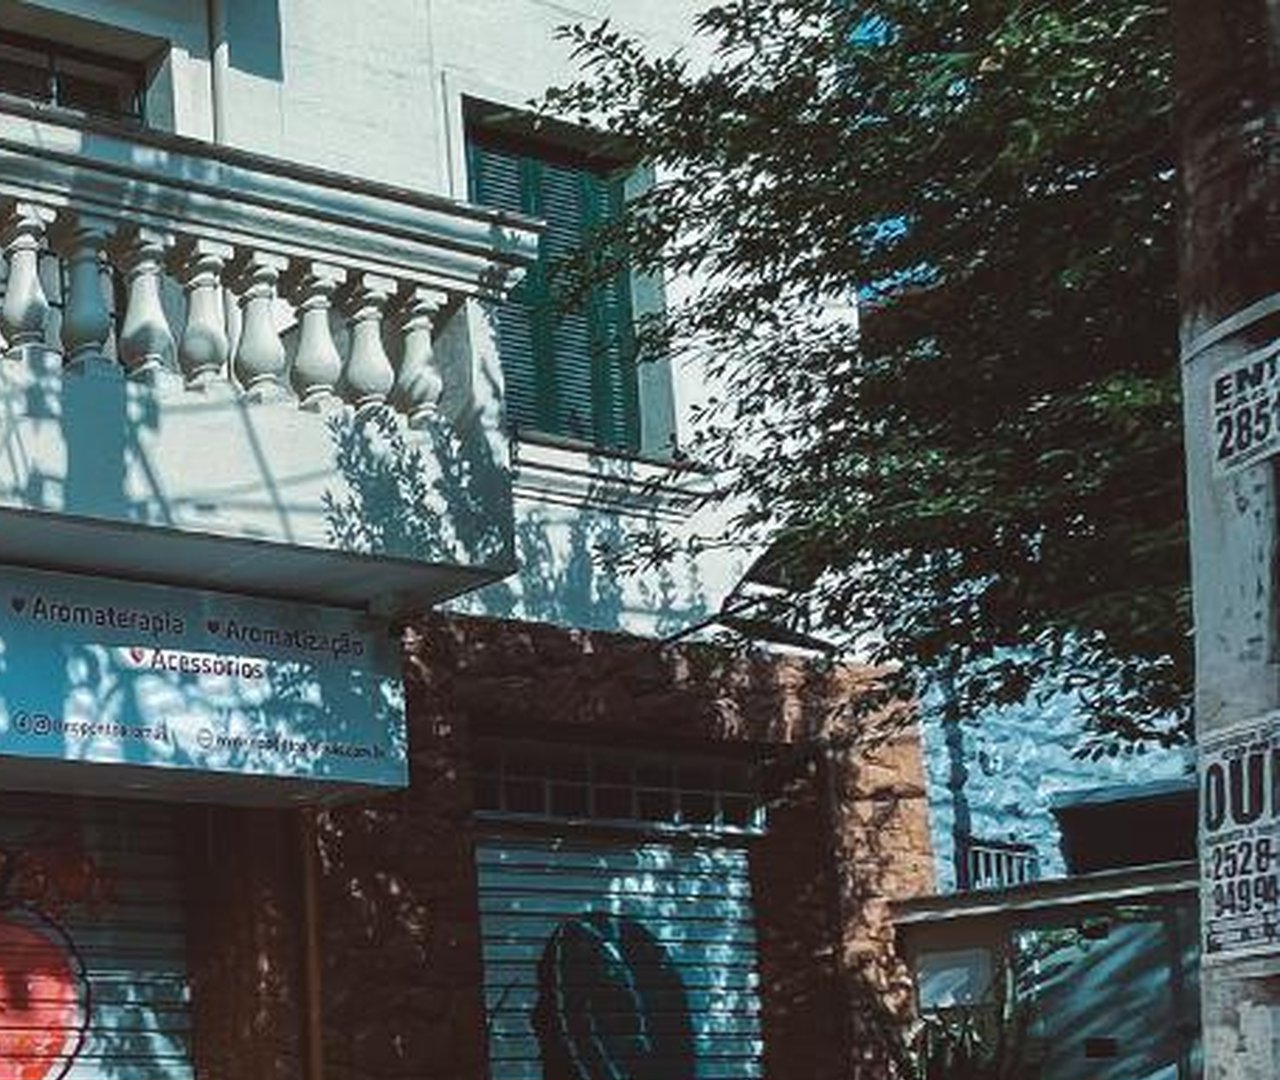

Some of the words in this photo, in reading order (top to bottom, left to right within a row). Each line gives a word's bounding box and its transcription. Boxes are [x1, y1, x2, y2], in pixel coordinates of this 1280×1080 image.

[32, 597, 186, 641] Aromaterapia
[226, 620, 365, 660] Aromatização
[151, 648, 265, 681] Acessórios
